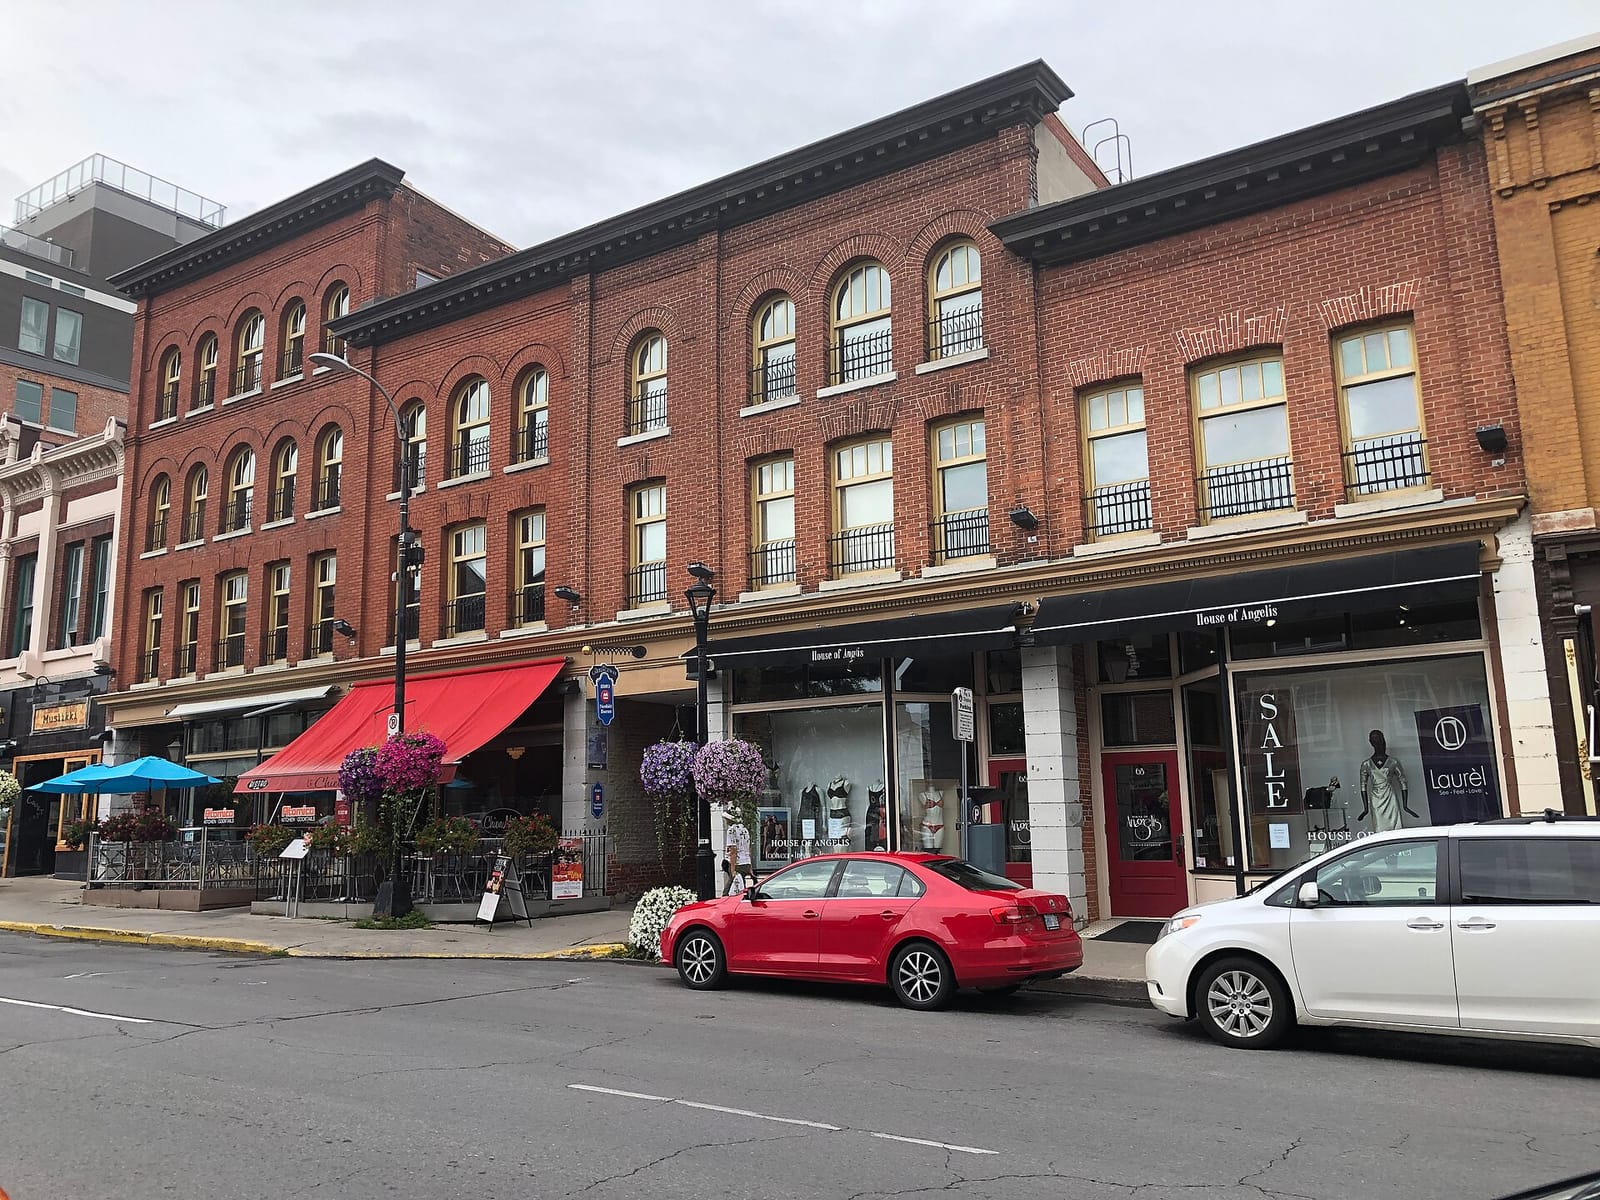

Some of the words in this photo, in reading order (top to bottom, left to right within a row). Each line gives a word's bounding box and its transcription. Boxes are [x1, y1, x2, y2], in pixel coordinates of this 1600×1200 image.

[1196, 613, 1225, 625] House
[1228, 609, 1238, 621] of
[1241, 604, 1277, 622] Angelis
[812, 650, 832, 661] House
[834, 649, 841, 659] of
[1260, 694, 1288, 808] SALE
[1430, 765, 1486, 789] Laurèl
[771, 839, 799, 847] HOUSE
[801, 839, 813, 847] OF
[814, 838, 850, 847] ANGELIS
[1307, 831, 1352, 841] HOUSE
